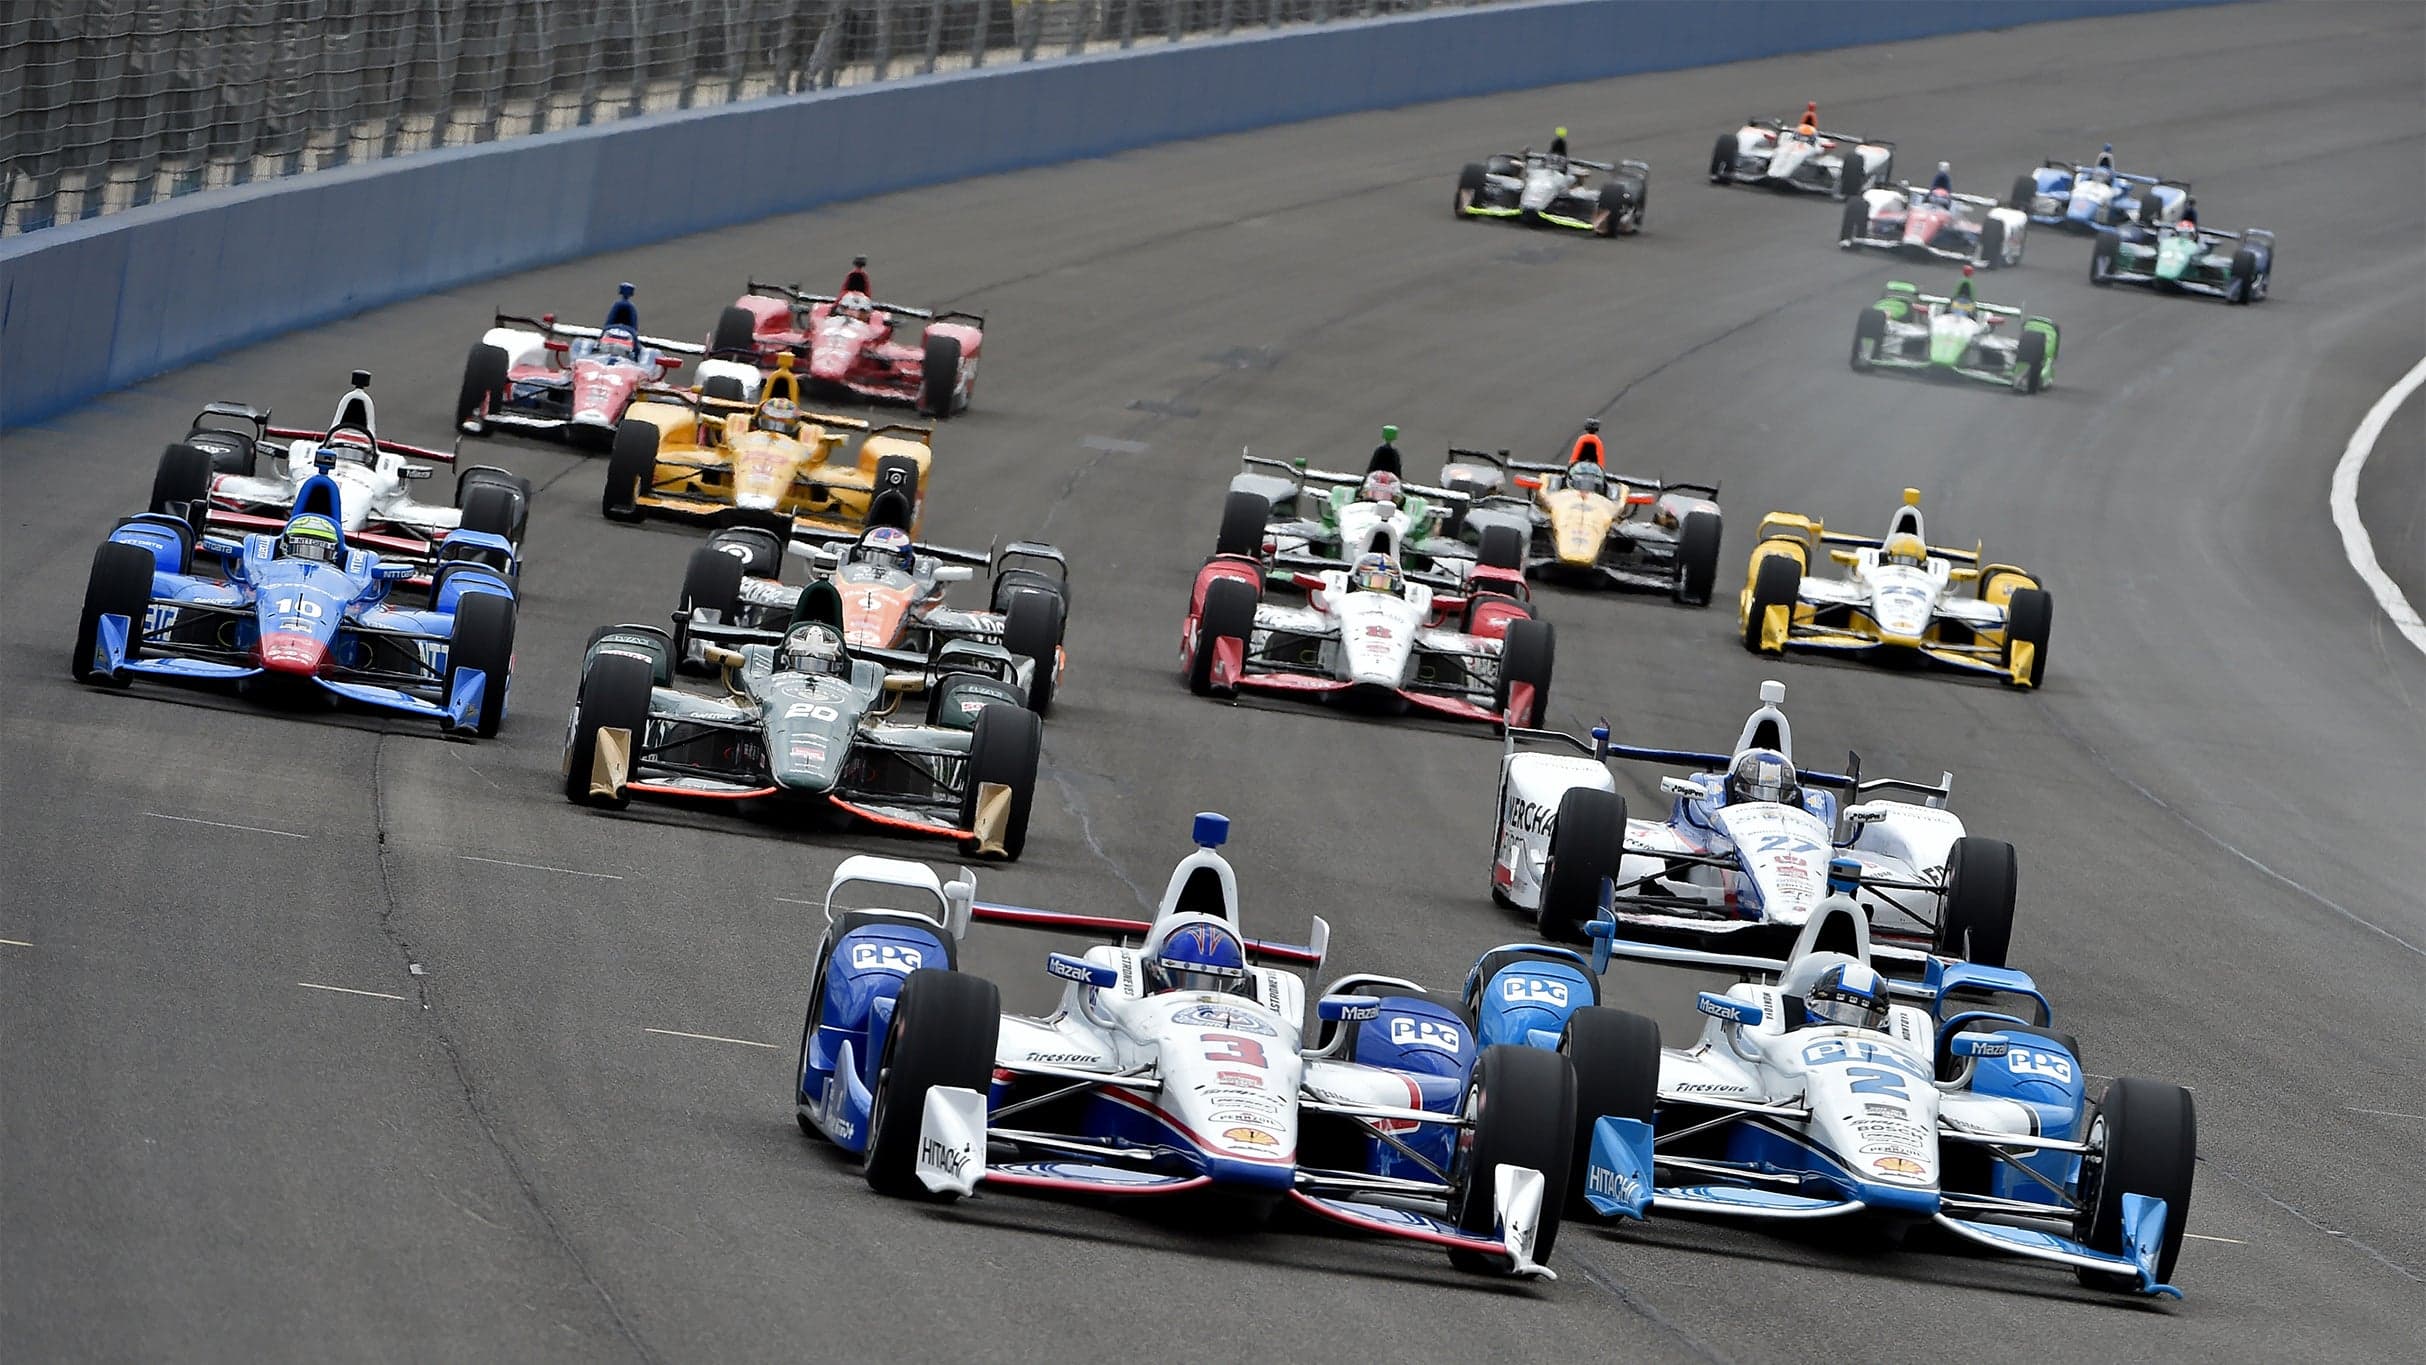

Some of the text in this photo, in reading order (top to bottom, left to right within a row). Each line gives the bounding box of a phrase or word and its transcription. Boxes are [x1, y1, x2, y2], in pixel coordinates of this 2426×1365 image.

[276, 599, 322, 618] 10
[784, 702, 839, 722] 20
[1757, 835, 1822, 854] 27
[854, 944, 923, 972] PPG
[1048, 958, 1093, 983] Mazak
[1504, 979, 1567, 1005] PPG
[1699, 997, 1741, 1021] Mazak
[1392, 1020, 1460, 1050] PPG
[1026, 1051, 1102, 1063] Firestone
[1200, 1032, 1269, 1069] 3
[1803, 1041, 1932, 1085] PPG
[2009, 1051, 2070, 1081] PPG
[1676, 1082, 1750, 1093] Firestone
[1847, 1066, 1911, 1102] 2
[1857, 1124, 1924, 1141] BOSCH
[921, 1137, 970, 1178] HITACHI
[1588, 1164, 1640, 1203] HITACHI
